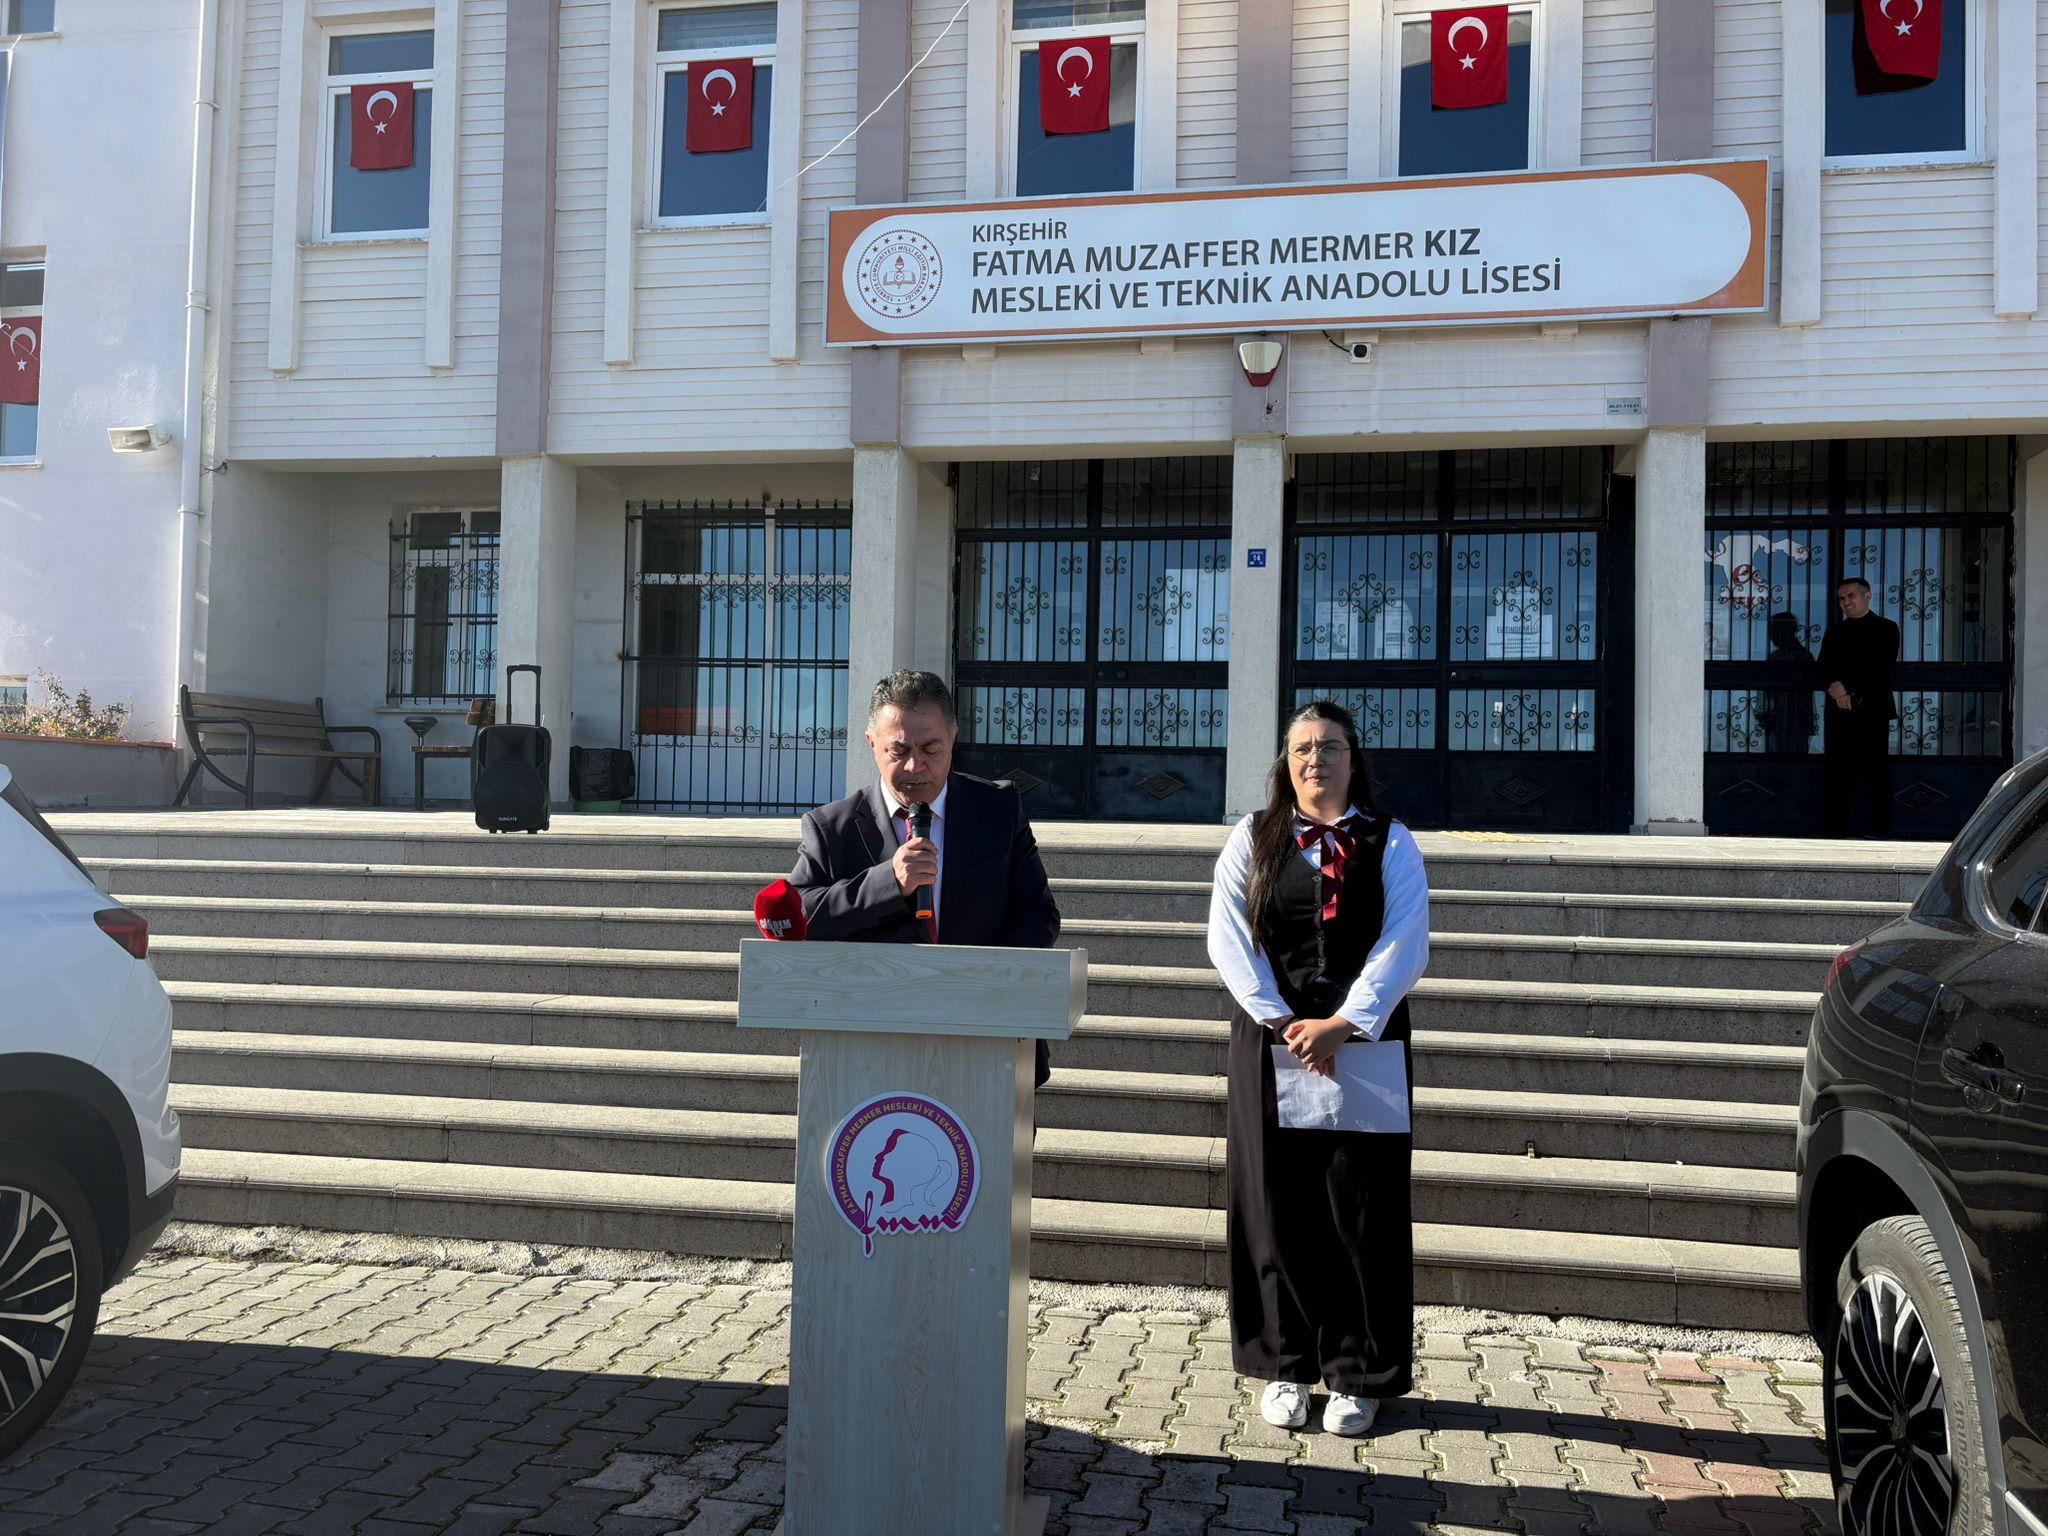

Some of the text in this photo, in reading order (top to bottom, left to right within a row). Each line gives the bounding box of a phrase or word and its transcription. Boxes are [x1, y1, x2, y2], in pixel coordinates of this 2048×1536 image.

[972, 218, 1067, 246] KIRŞEHİR
[972, 228, 1481, 277] FATMA MUZAFFER MERMER KIZ
[971, 257, 1562, 314] MESLEKİ VE TEKNİK ANADOLU LİSESİ
[849, 1107, 881, 1136] MERMER
[883, 1102, 923, 1112] MESLEKİ
[924, 1108, 934, 1117] VE
[935, 1113, 961, 1143] TEKNİK
[837, 1135, 852, 1183] MUZAFFER
[957, 1143, 969, 1187] ANADOLU
[838, 1185, 857, 1214] FATMA
